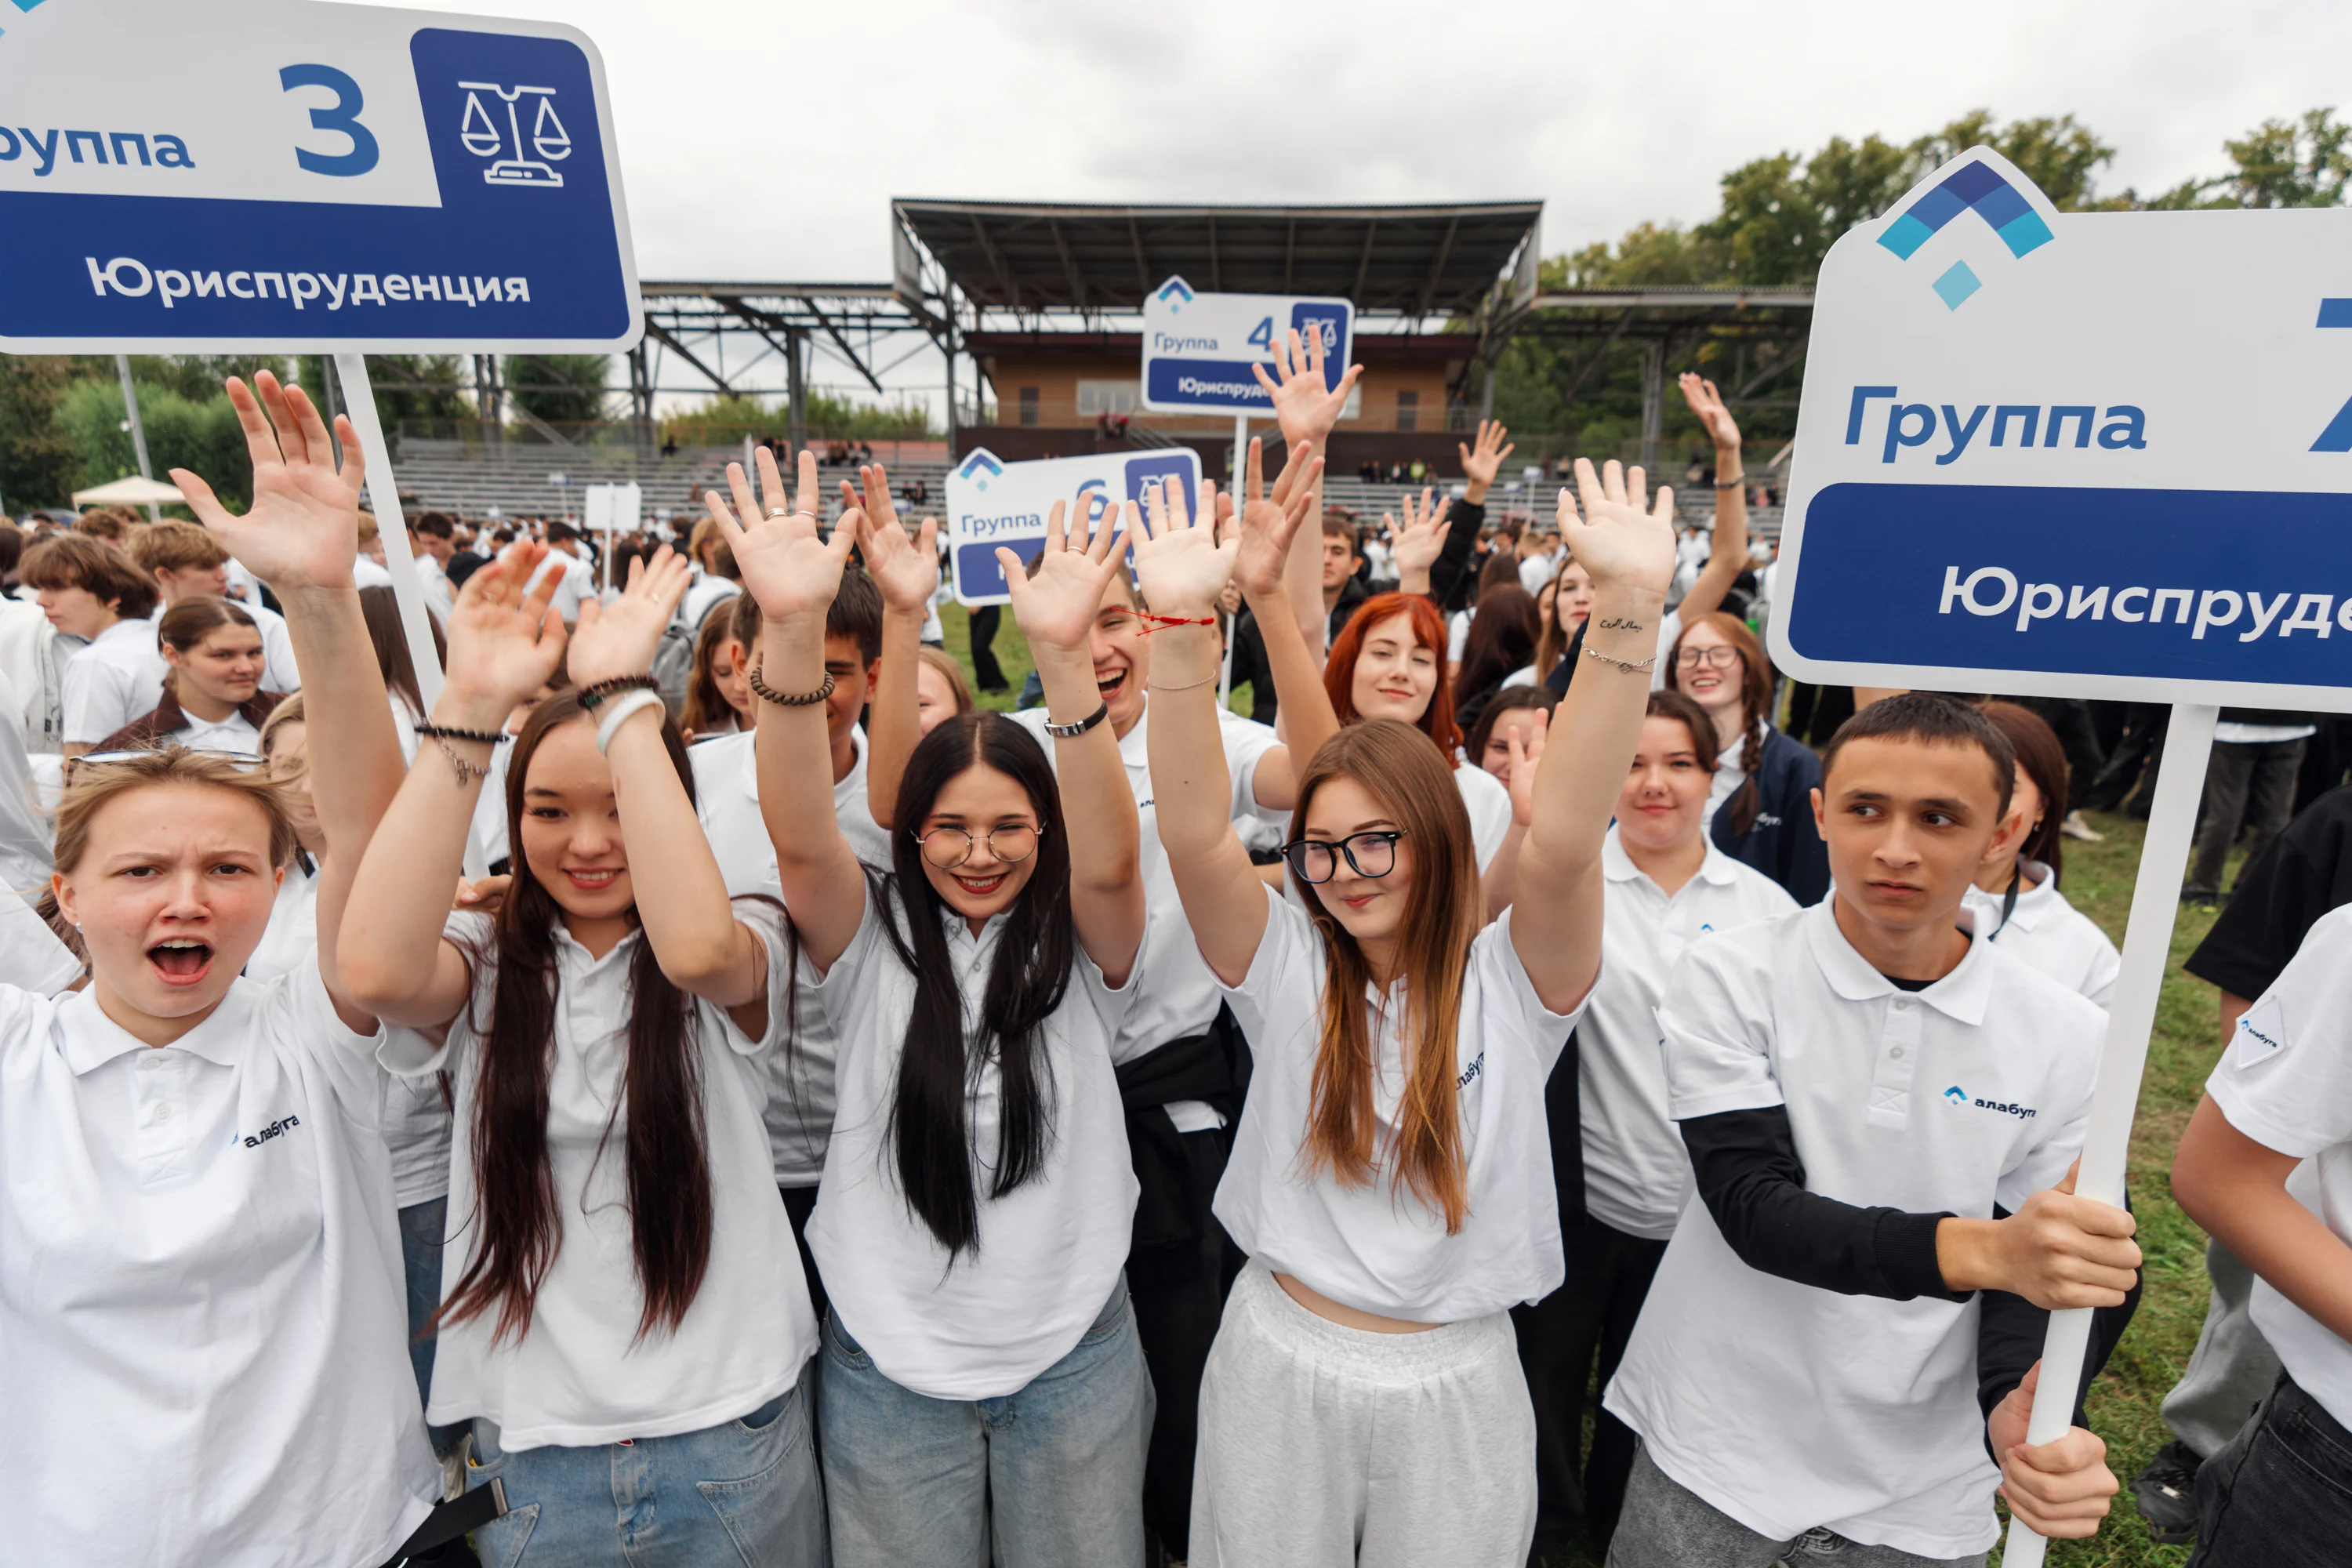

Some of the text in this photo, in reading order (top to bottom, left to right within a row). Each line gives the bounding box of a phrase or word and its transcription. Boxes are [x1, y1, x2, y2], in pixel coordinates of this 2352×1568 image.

[279, 64, 379, 177] 3
[85, 257, 531, 310] Юриспруденция
[1155, 316, 1273, 353] Группа 4
[1845, 386, 2147, 466] Группа
[962, 514, 1041, 537] Группа
[2249, 1028, 2278, 1047] алабуга
[244, 1115, 299, 1149] алабуга
